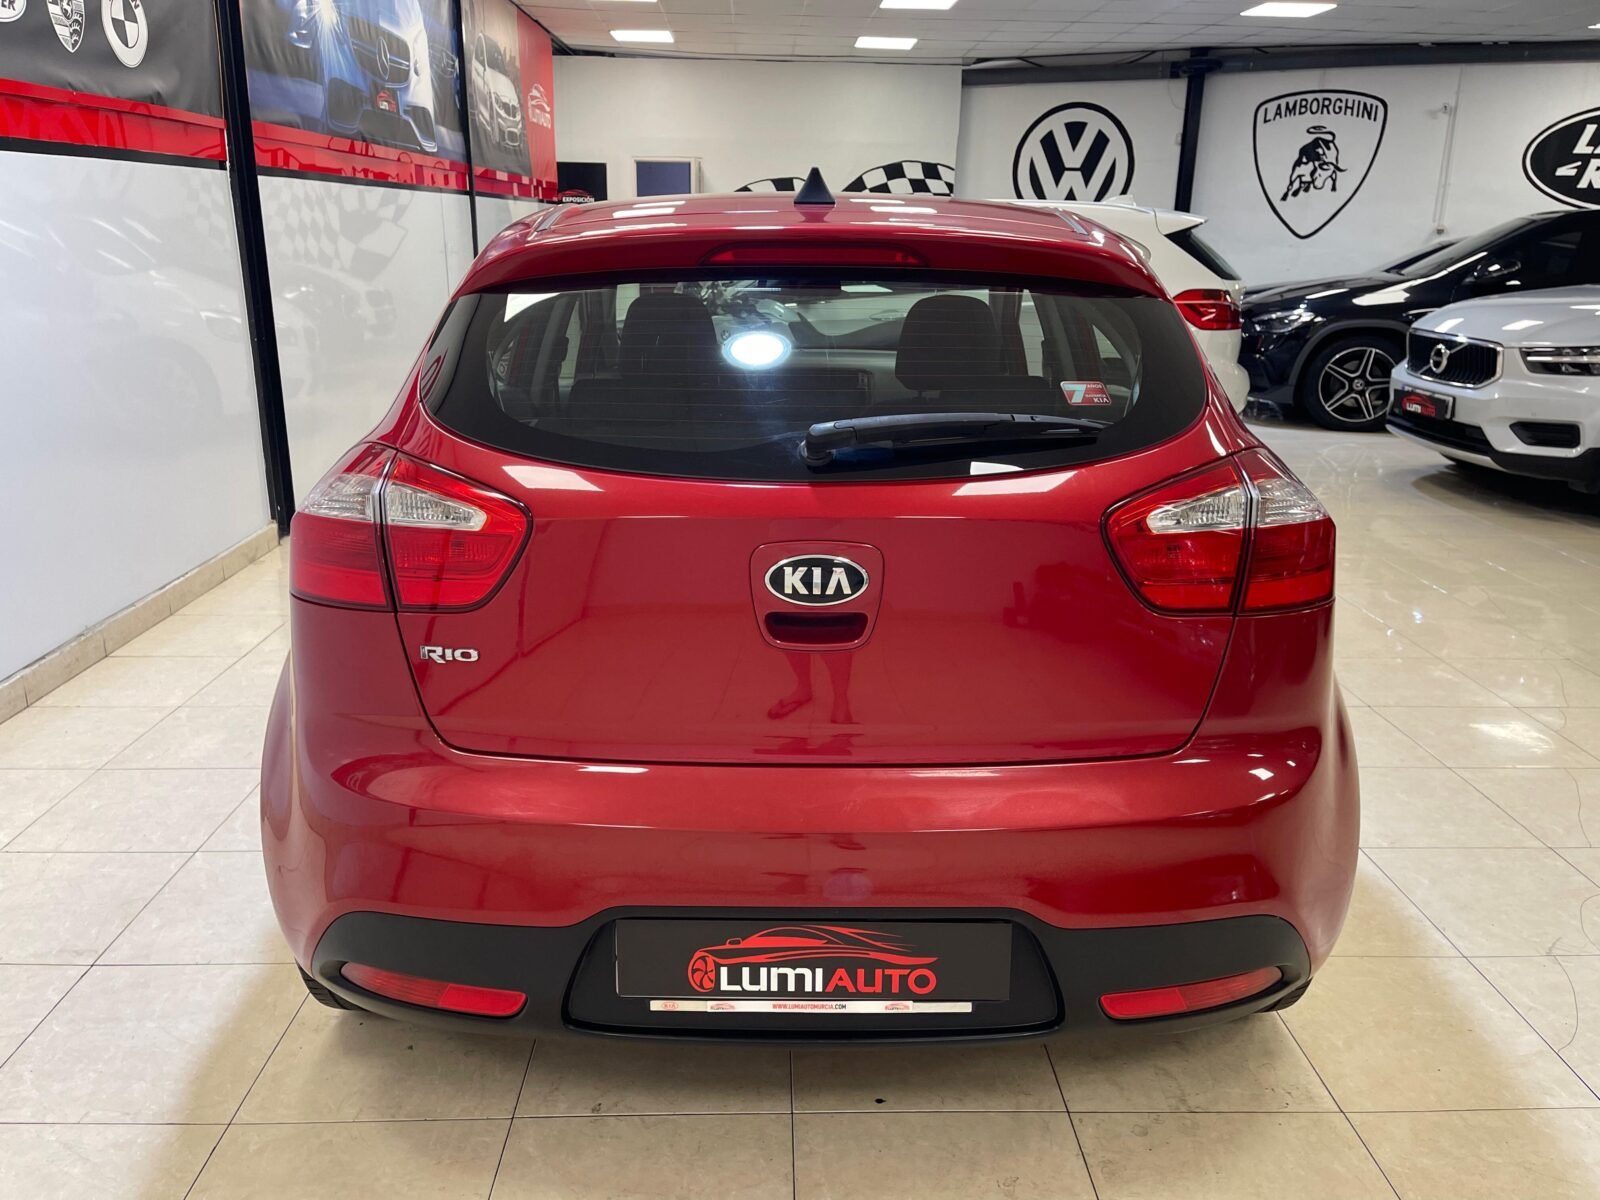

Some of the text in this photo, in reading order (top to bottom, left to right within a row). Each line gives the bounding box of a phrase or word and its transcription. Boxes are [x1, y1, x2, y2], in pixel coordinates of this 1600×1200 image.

[1263, 97, 1379, 124] LAMBORGHINI
[783, 566, 852, 595] KIA
[420, 645, 479, 664] RIO
[719, 966, 938, 995] LUMIAUTO
